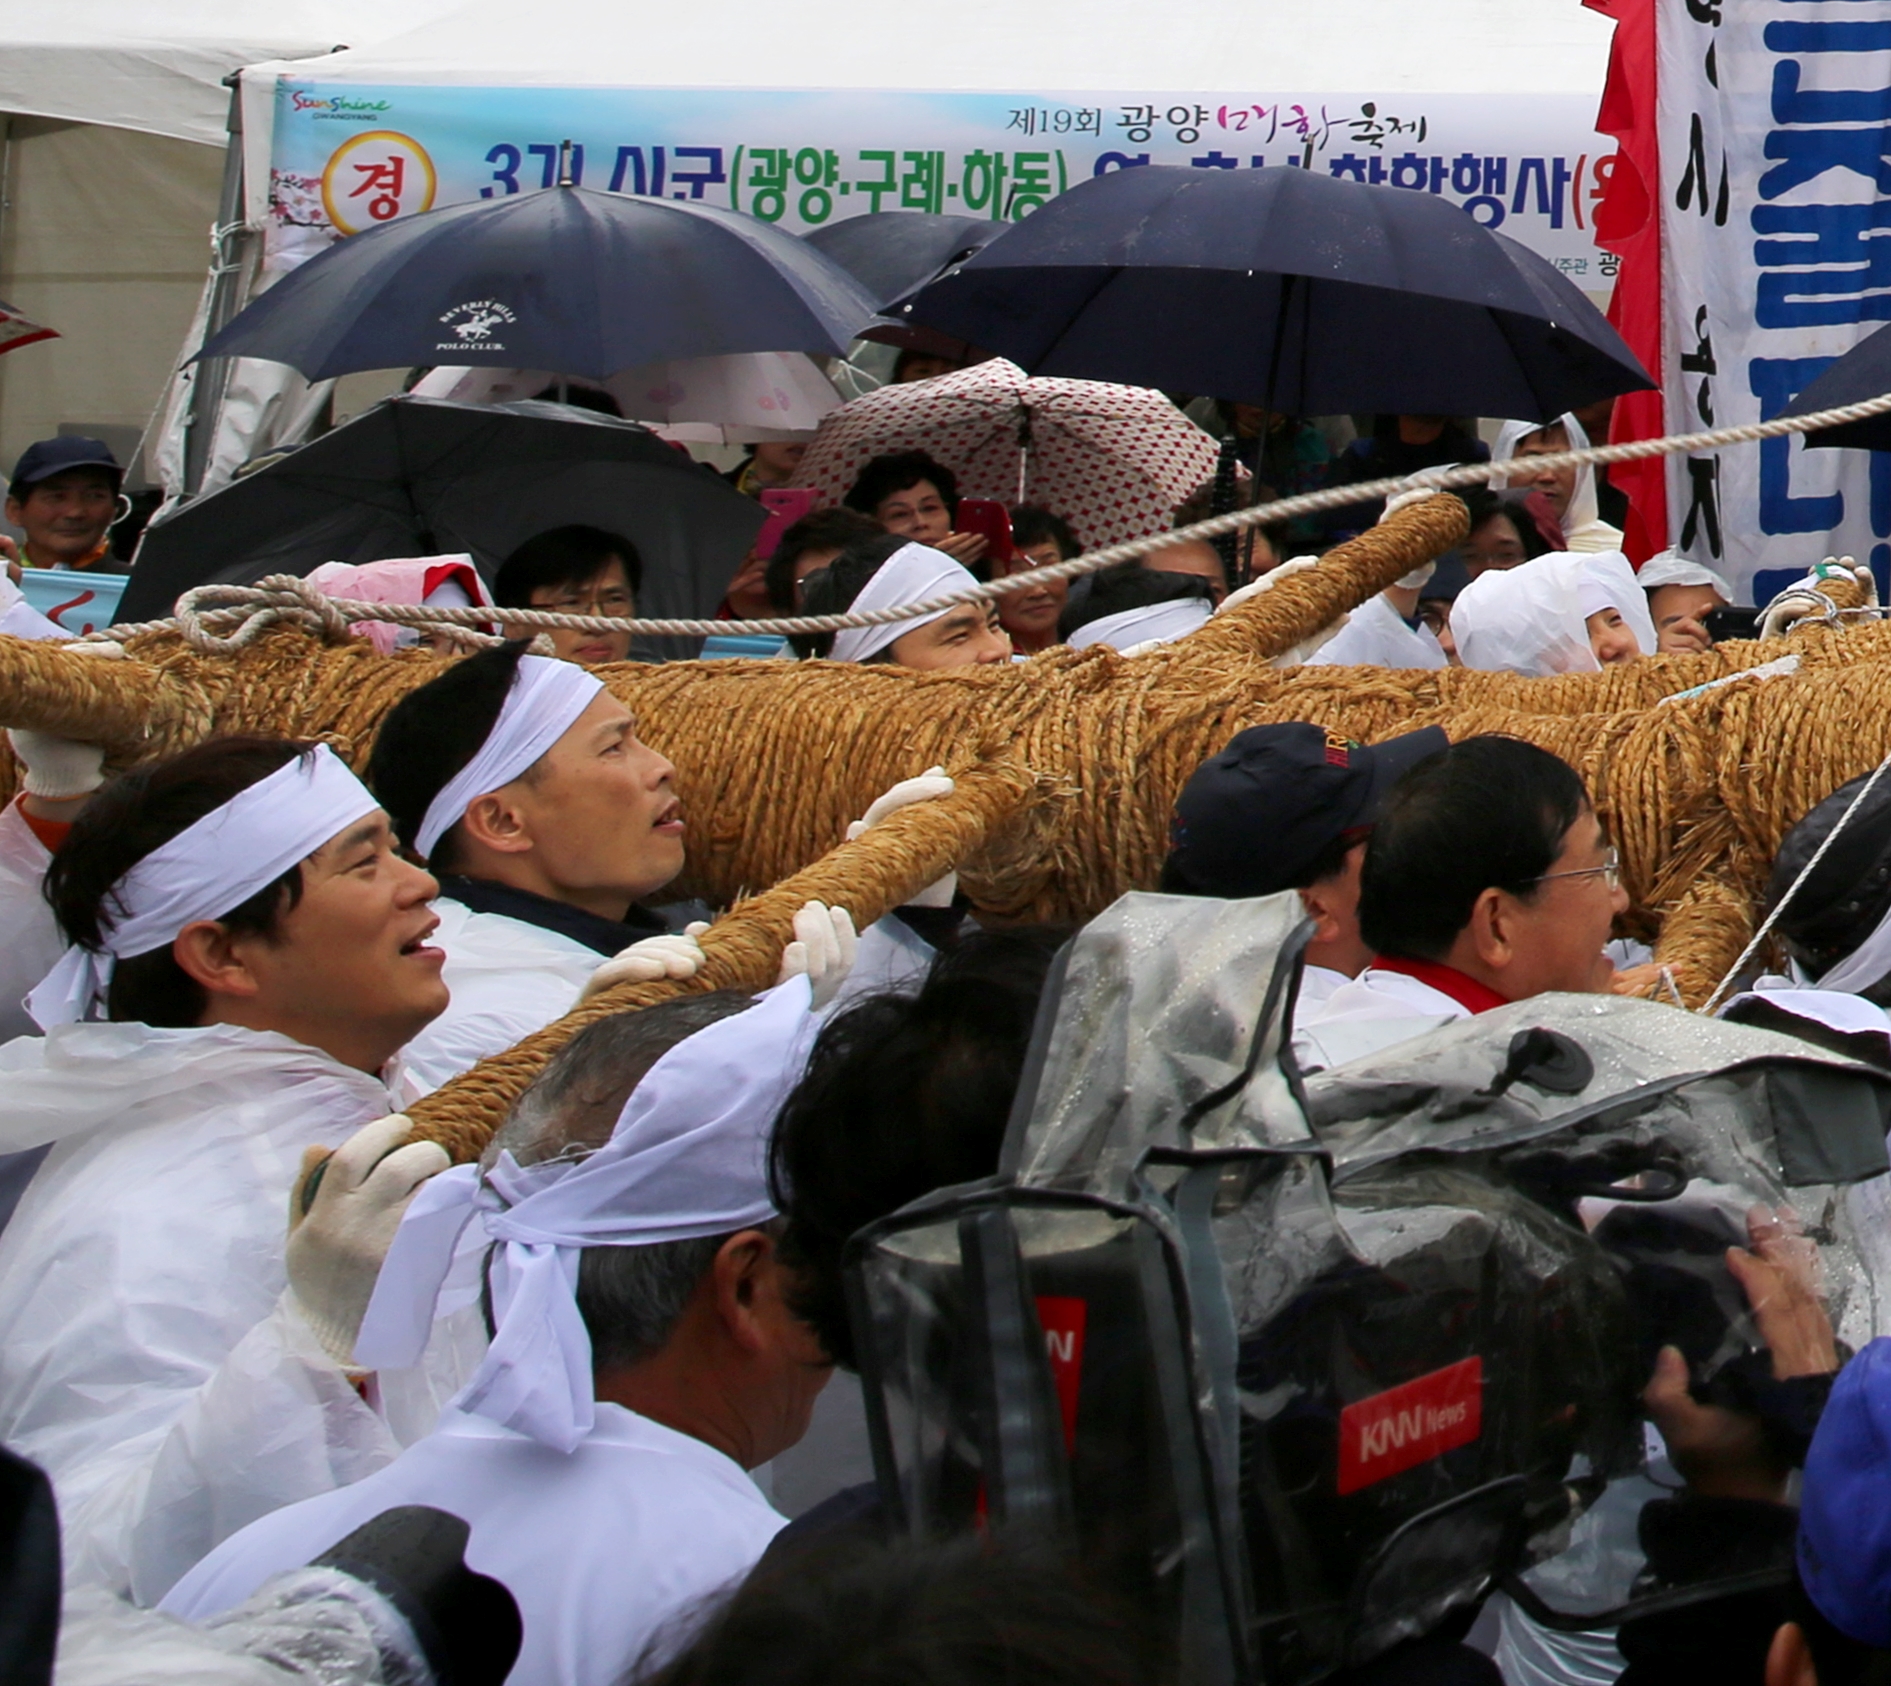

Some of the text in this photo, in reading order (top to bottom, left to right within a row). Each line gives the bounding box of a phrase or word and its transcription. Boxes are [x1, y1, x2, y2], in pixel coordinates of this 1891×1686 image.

[292, 90, 392, 112] Sunshine
[1006, 106, 1103, 137] 제19회
[348, 155, 405, 221] 경
[439, 300, 517, 324] BEVERLY HILLS
[436, 342, 469, 350] POLO
[1359, 1401, 1466, 1464] KNN News
